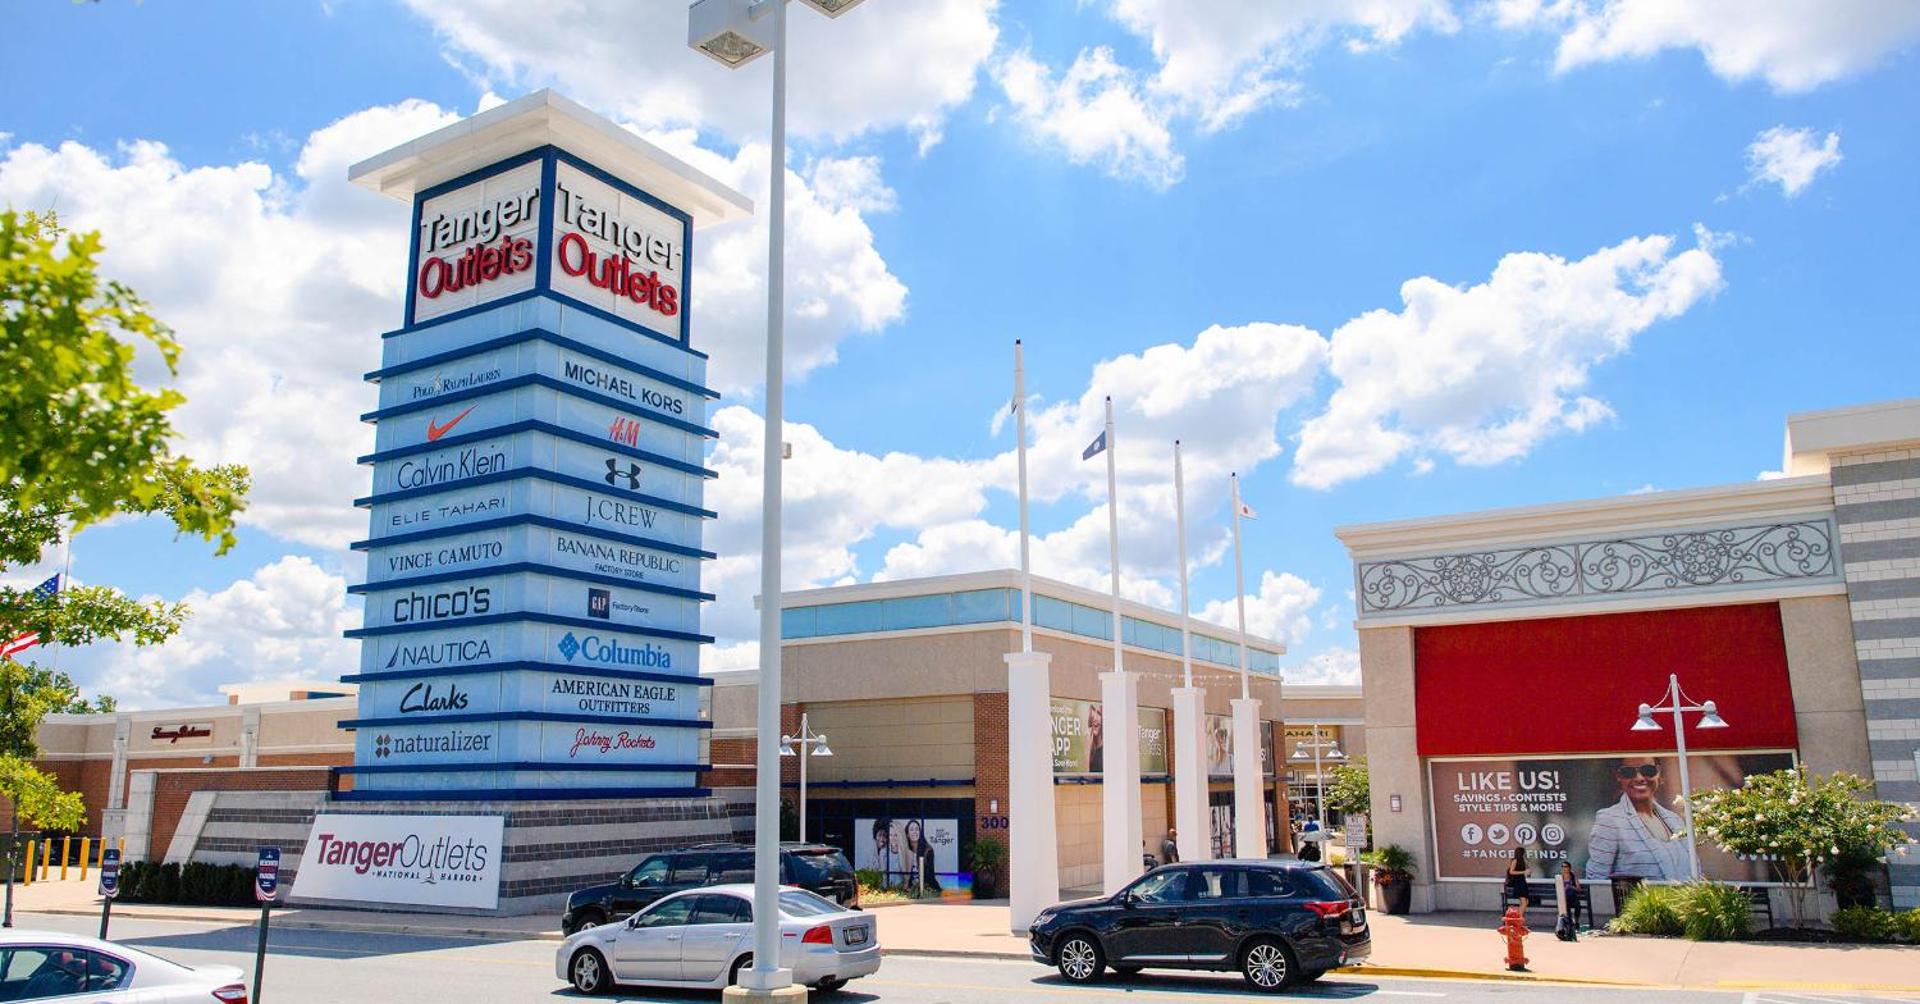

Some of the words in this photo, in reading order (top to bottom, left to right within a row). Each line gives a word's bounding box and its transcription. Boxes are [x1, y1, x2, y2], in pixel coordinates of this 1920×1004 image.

[421, 188, 540, 252] Tanger
[557, 181, 681, 270] Tanger
[420, 235, 533, 299] Outlets
[559, 232, 678, 316] Outlets
[565, 361, 637, 400] MICHAEL
[641, 388, 683, 415] KORS
[397, 454, 454, 489] Calvin
[458, 444, 506, 478] Klein
[392, 510, 431, 526] ELIE
[438, 498, 506, 519] TAHARI
[584, 496, 658, 529] J.CREW
[389, 551, 433, 572] VINCE
[438, 541, 503, 566] CAMUTO
[557, 537, 616, 562] BANANA
[620, 549, 680, 574] REPUBLIC
[402, 640, 491, 667] NAUTICA
[581, 635, 671, 669] Columbia
[400, 682, 469, 713] Clarks
[552, 679, 630, 699] AMERICAN
[634, 685, 676, 701] EAGLE
[578, 698, 650, 714] OUTFITTERS
[1050, 716, 1081, 735] NGER
[393, 730, 491, 754] naturalizer
[570, 727, 613, 758] Johnny
[613, 730, 656, 750] Rockets
[1457, 771, 1512, 790] LIKE
[1518, 770, 1560, 790] US!
[1453, 793, 1500, 803] SAVINGS
[1508, 793, 1567, 802] CONTESTS
[1458, 804, 1492, 812] STYLE
[1494, 804, 1518, 812] TIPS
[1520, 804, 1528, 812] &
[1529, 803, 1563, 812] MORE
[981, 816, 1009, 830] 300
[1462, 849, 1567, 859] #TANGEFINDS
[376, 870, 420, 880] NATIONAL
[440, 873, 477, 882] HARBOR
